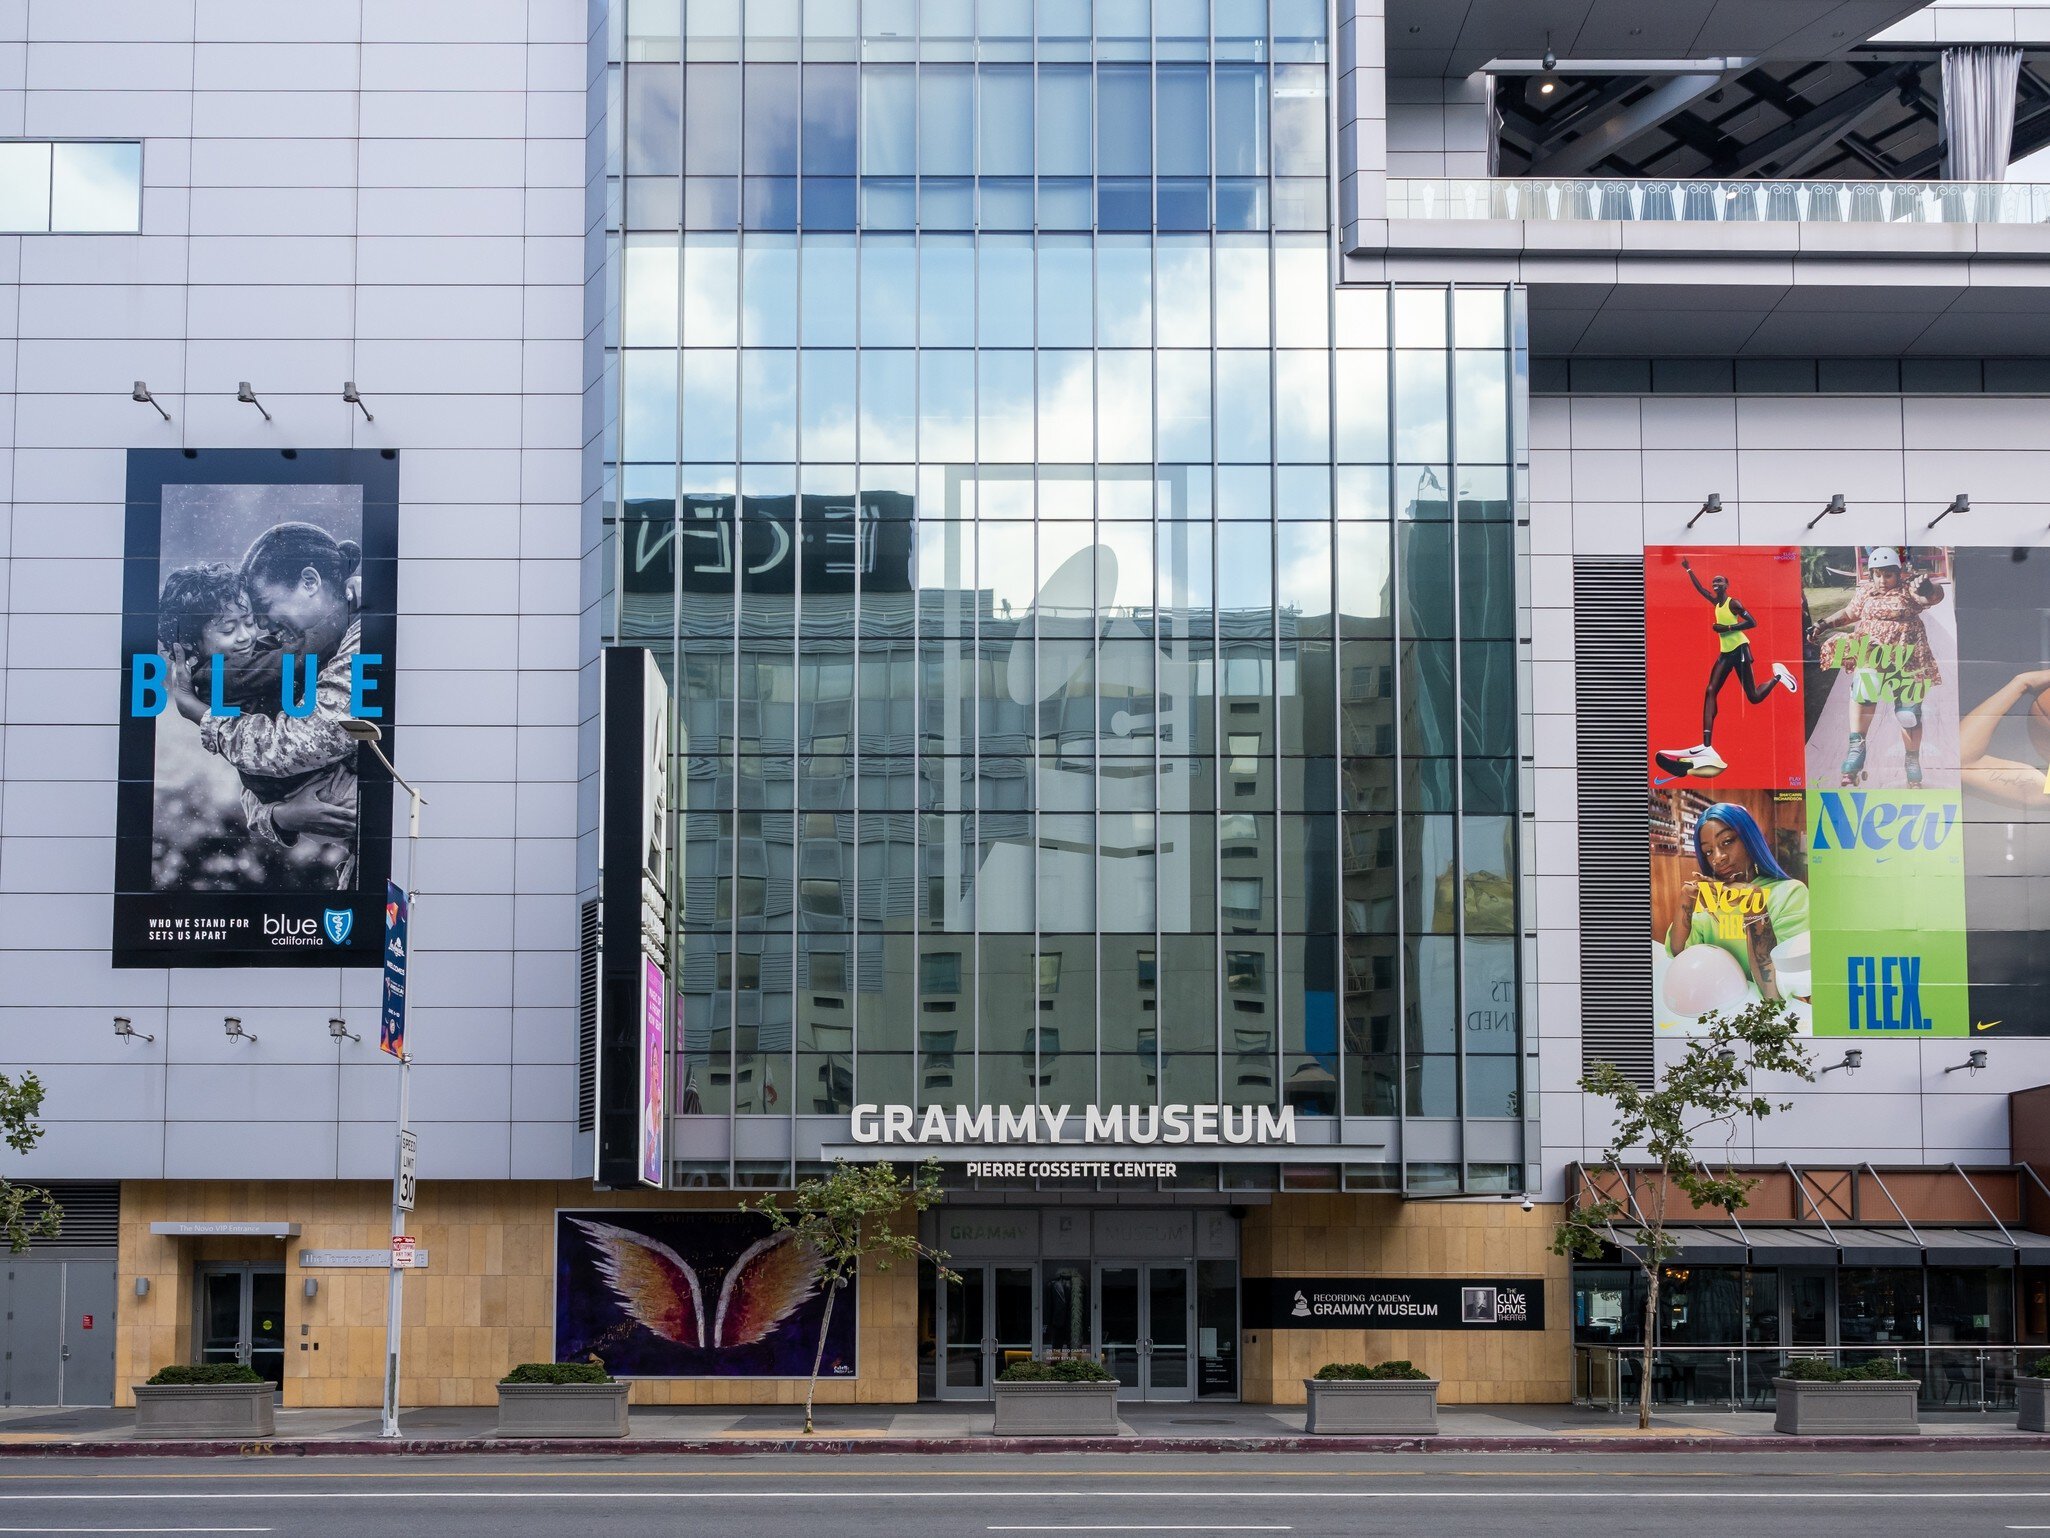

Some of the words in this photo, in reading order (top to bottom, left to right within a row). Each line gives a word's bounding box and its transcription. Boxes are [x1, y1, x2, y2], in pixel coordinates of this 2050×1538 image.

[1829, 634, 1918, 679] Play
[132, 654, 382, 717] BLUE
[1856, 673, 1932, 704] New
[1812, 792, 1958, 850] New
[1694, 882, 1771, 913] New
[149, 919, 171, 928] WHO
[175, 919, 190, 928] WE
[194, 919, 226, 928] STAND
[230, 919, 249, 928] FOR
[263, 913, 317, 934] blue
[149, 931, 174, 940] SETS
[178, 931, 191, 940] US
[194, 931, 227, 940] APART
[271, 936, 323, 945] california
[1848, 957, 1932, 1030] FLEX.
[851, 1103, 1070, 1144] GRAMMY
[1085, 1103, 1296, 1144] MUSEUM
[402, 1138, 416, 1153] SPEED
[403, 1155, 414, 1169] LIMIT
[966, 1161, 1026, 1177] PIERRE
[1029, 1162, 1110, 1177] COSSETTE
[1113, 1162, 1177, 1178] CENTER
[401, 1173, 414, 1203] 30
[179, 1224, 192, 1232] The
[194, 1224, 214, 1232] Novo
[215, 1224, 228, 1232] VIP
[228, 1224, 260, 1232] Entrance
[950, 1225, 1027, 1240] GRAMMY
[305, 1253, 323, 1264] The
[324, 1253, 363, 1264] Terrace
[1313, 1294, 1365, 1302] RECORDING
[1369, 1294, 1411, 1302] ACADEMY
[1497, 1294, 1527, 1304] CLIVE
[1313, 1304, 1373, 1316] GRAMMY
[1377, 1304, 1438, 1316] MUSEUM
[1497, 1304, 1527, 1314] DAVIS
